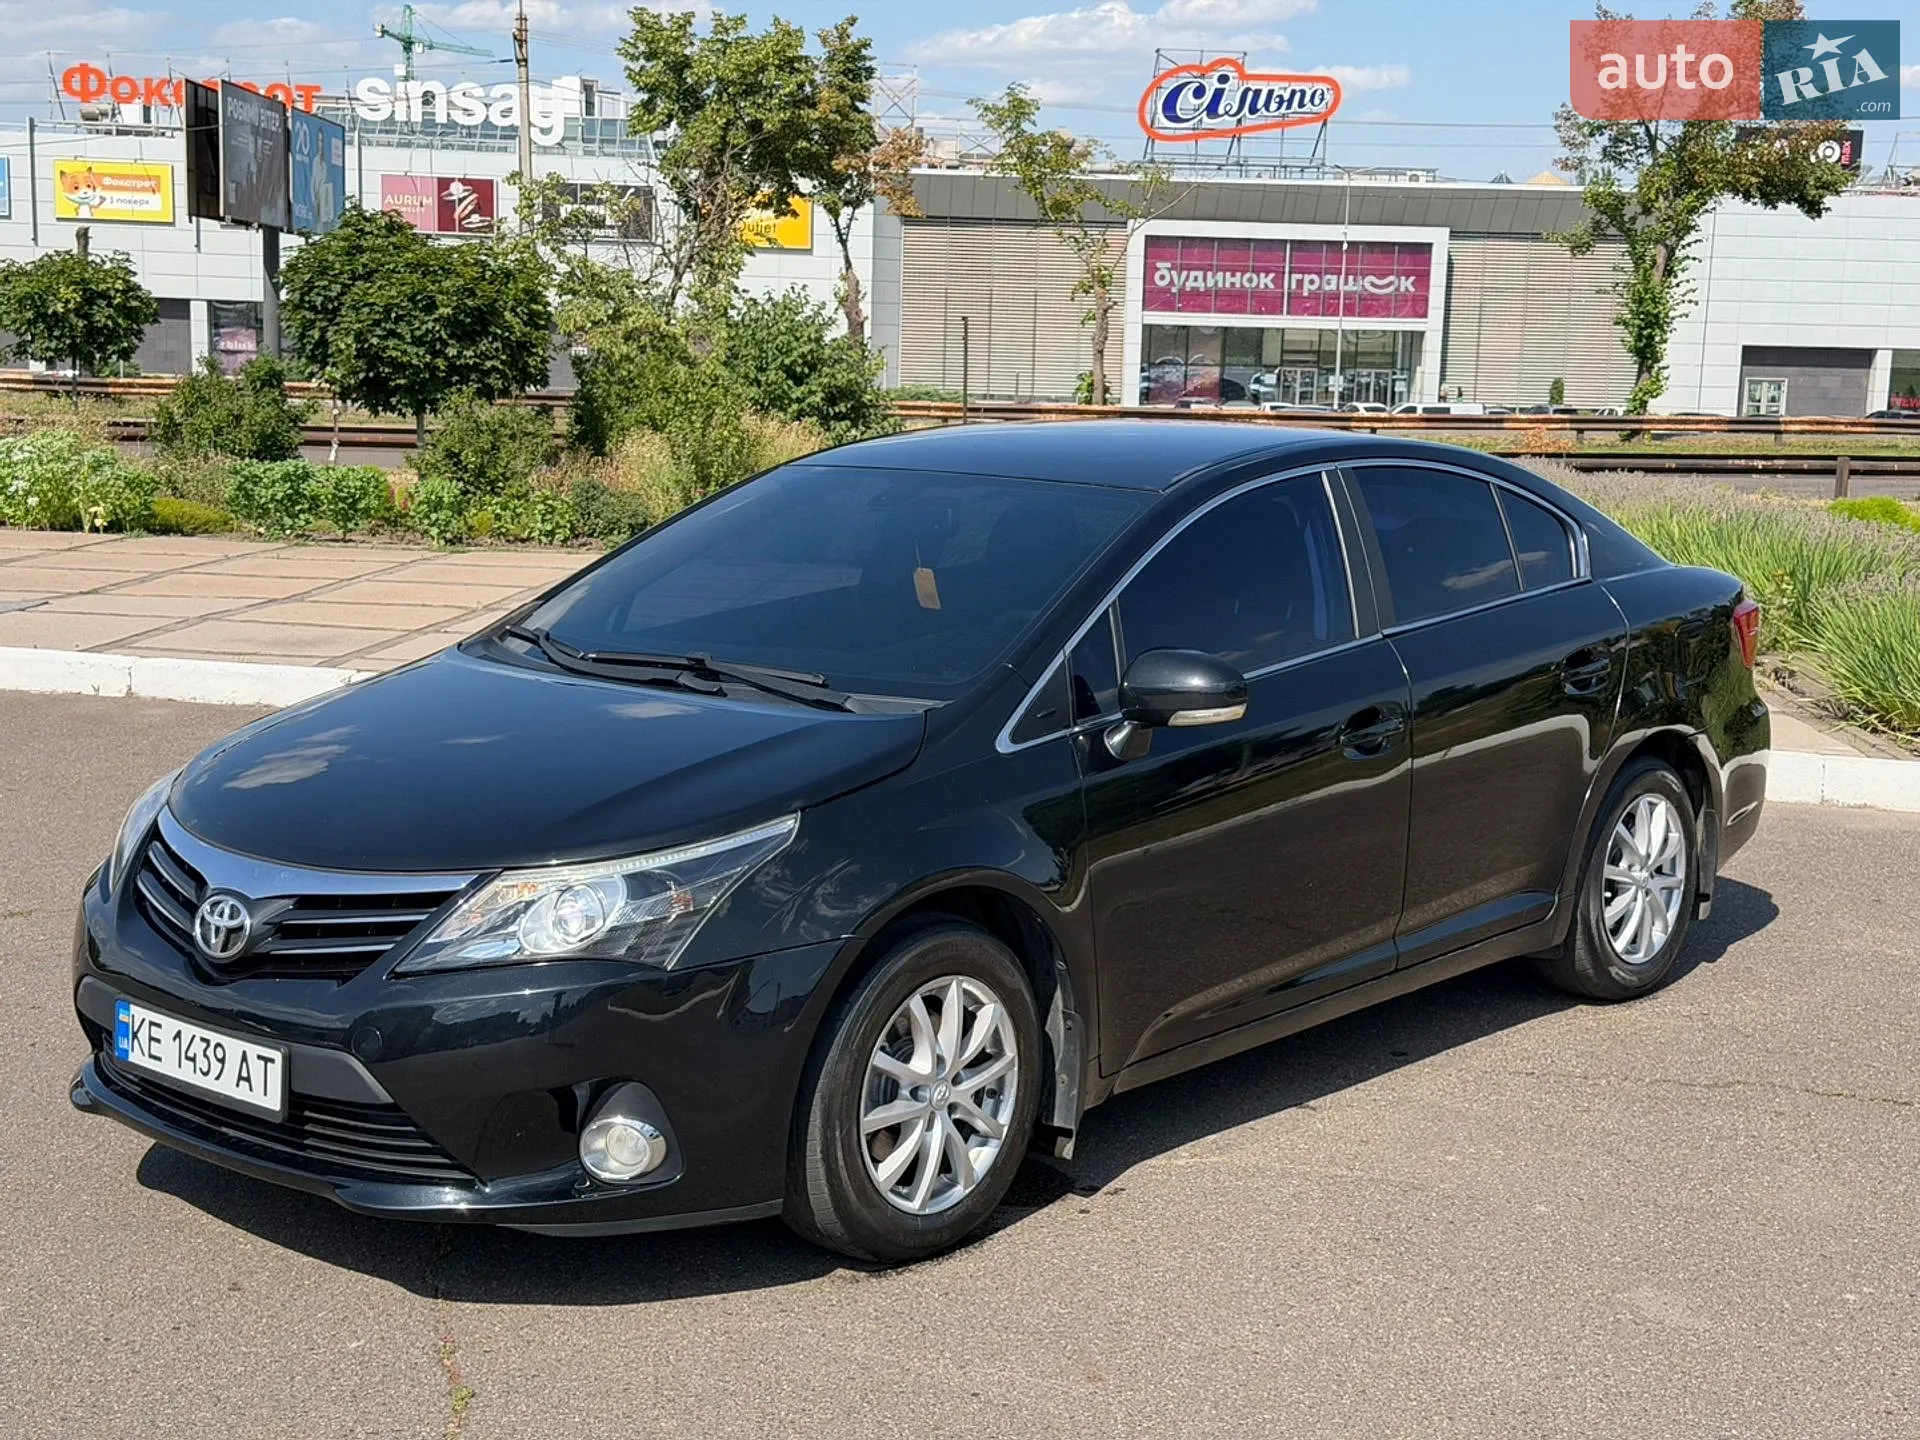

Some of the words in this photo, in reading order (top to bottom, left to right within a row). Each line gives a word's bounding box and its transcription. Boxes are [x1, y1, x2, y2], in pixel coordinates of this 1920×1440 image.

[1161, 73, 1326, 124] Сільпо
[102, 176, 157, 190] Фокстрот
[116, 198, 151, 207] поверх
[384, 194, 433, 206] AURUM
[1153, 261, 1277, 293] будинок
[131, 1014, 163, 1062] KE
[172, 1029, 227, 1082] 1439
[236, 1050, 276, 1097] AT
